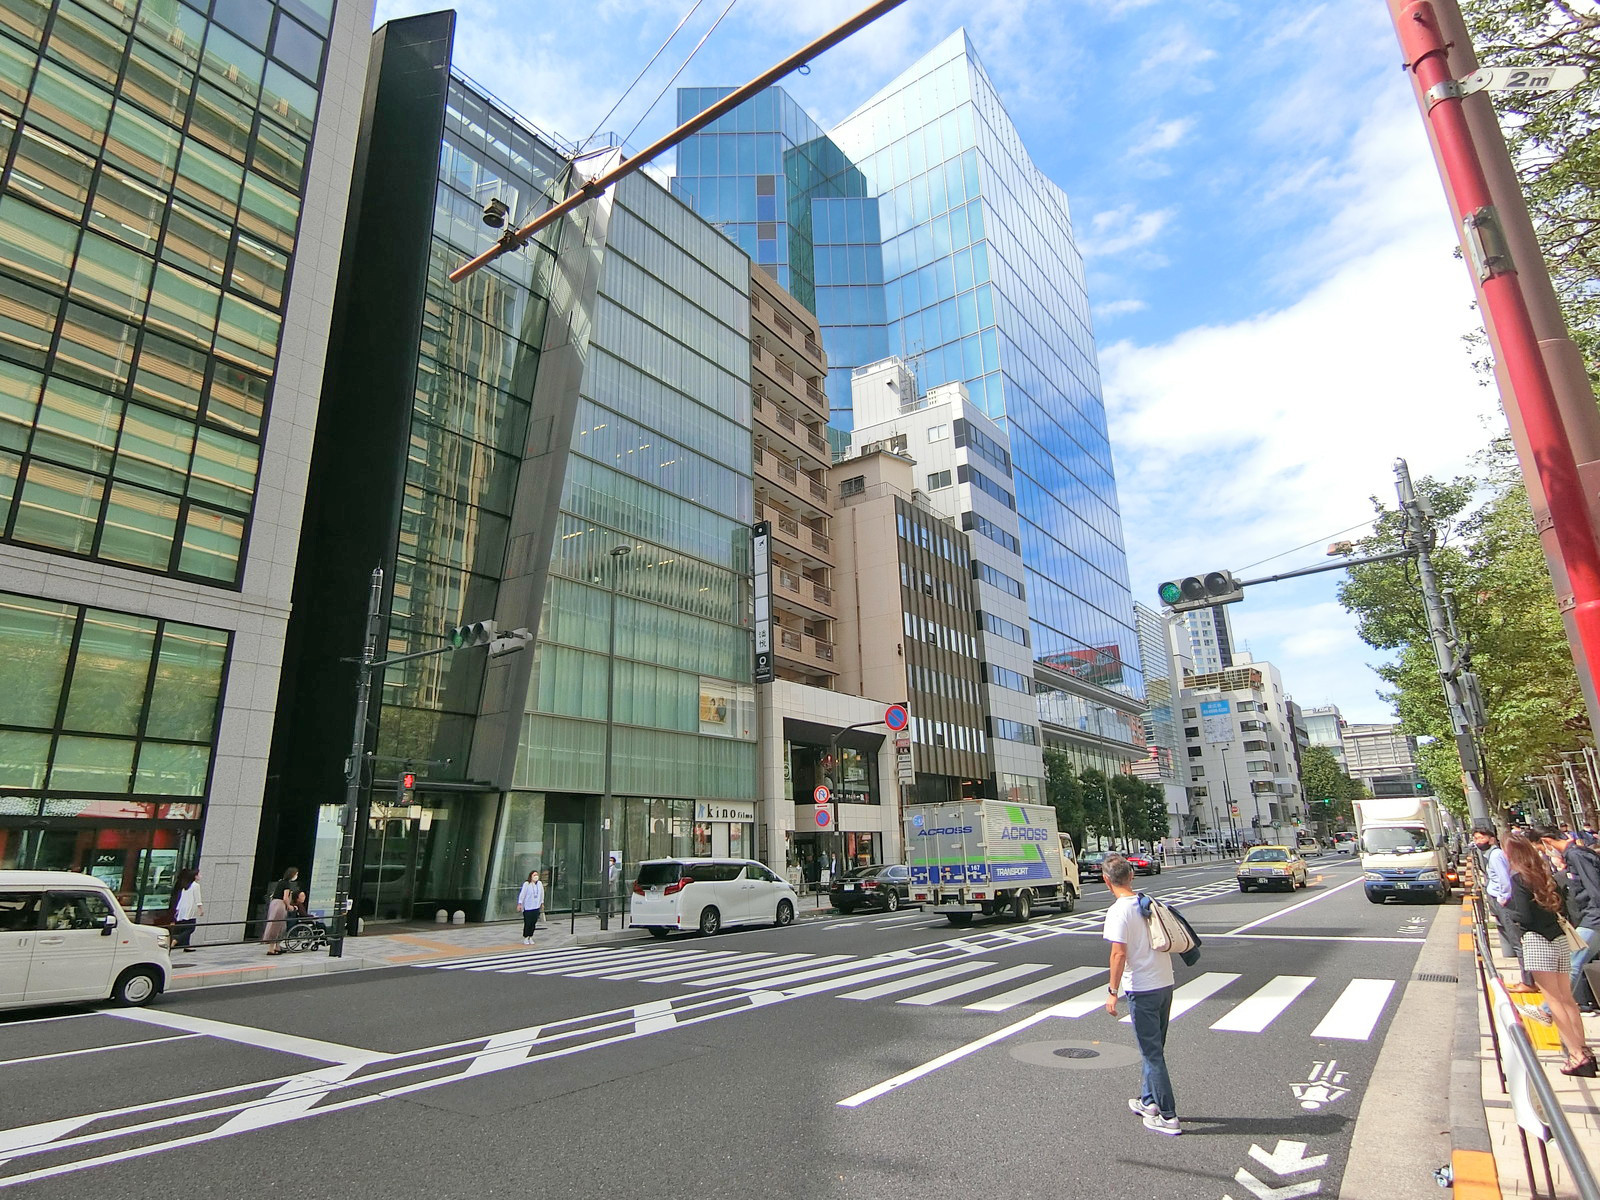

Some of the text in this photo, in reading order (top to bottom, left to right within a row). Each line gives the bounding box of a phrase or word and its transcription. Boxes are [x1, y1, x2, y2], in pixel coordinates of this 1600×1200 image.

[707, 803, 753, 819] kino films
[917, 826, 973, 836] ACROSS
[1001, 826, 1048, 841] ACROSS
[996, 867, 1029, 876] TRANSPORT
